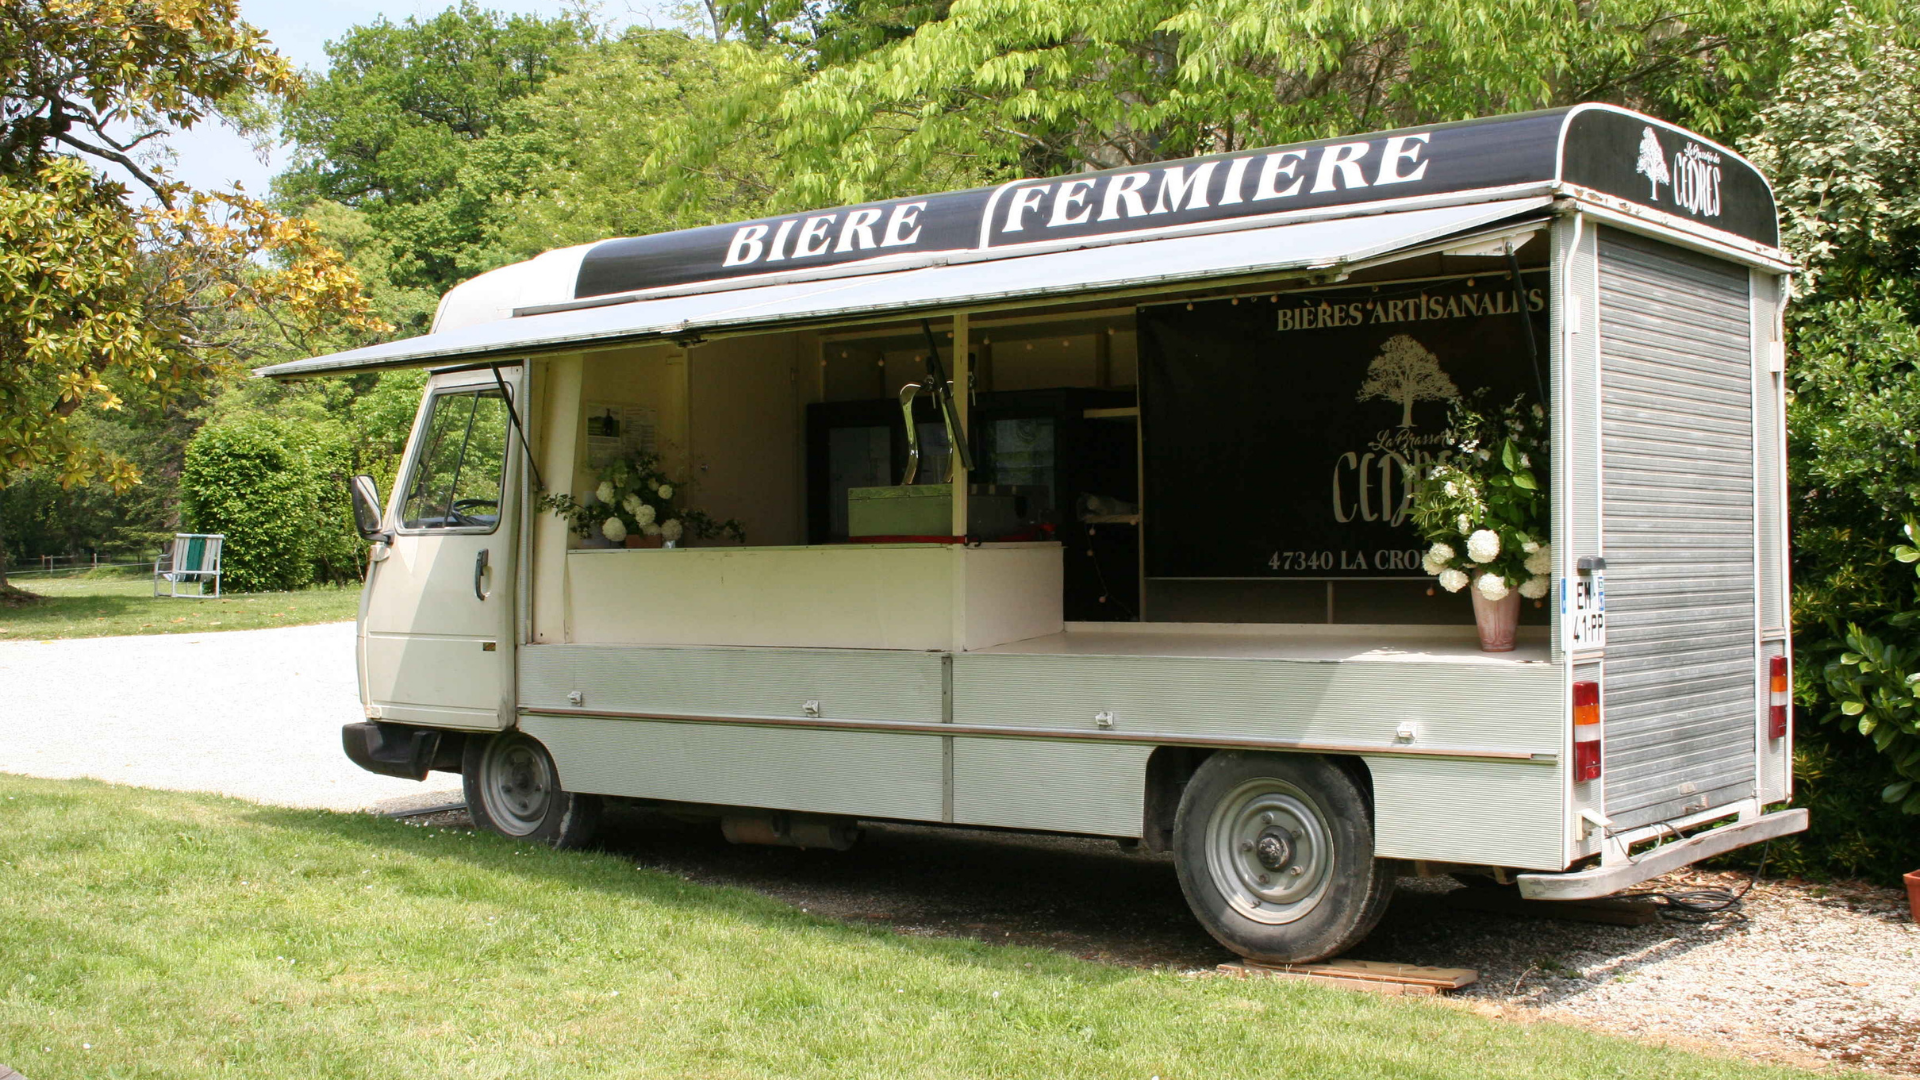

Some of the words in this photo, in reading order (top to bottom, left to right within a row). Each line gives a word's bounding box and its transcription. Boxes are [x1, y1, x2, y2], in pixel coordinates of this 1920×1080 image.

[722, 201, 928, 268] BIERE
[1002, 132, 1430, 233] FERMIERE
[1673, 152, 1721, 217] CEDRES
[1277, 300, 1363, 332] BIÈRES
[1368, 429, 1396, 452] La
[1268, 550, 1334, 571] 47340
[1340, 550, 1369, 570] LA
